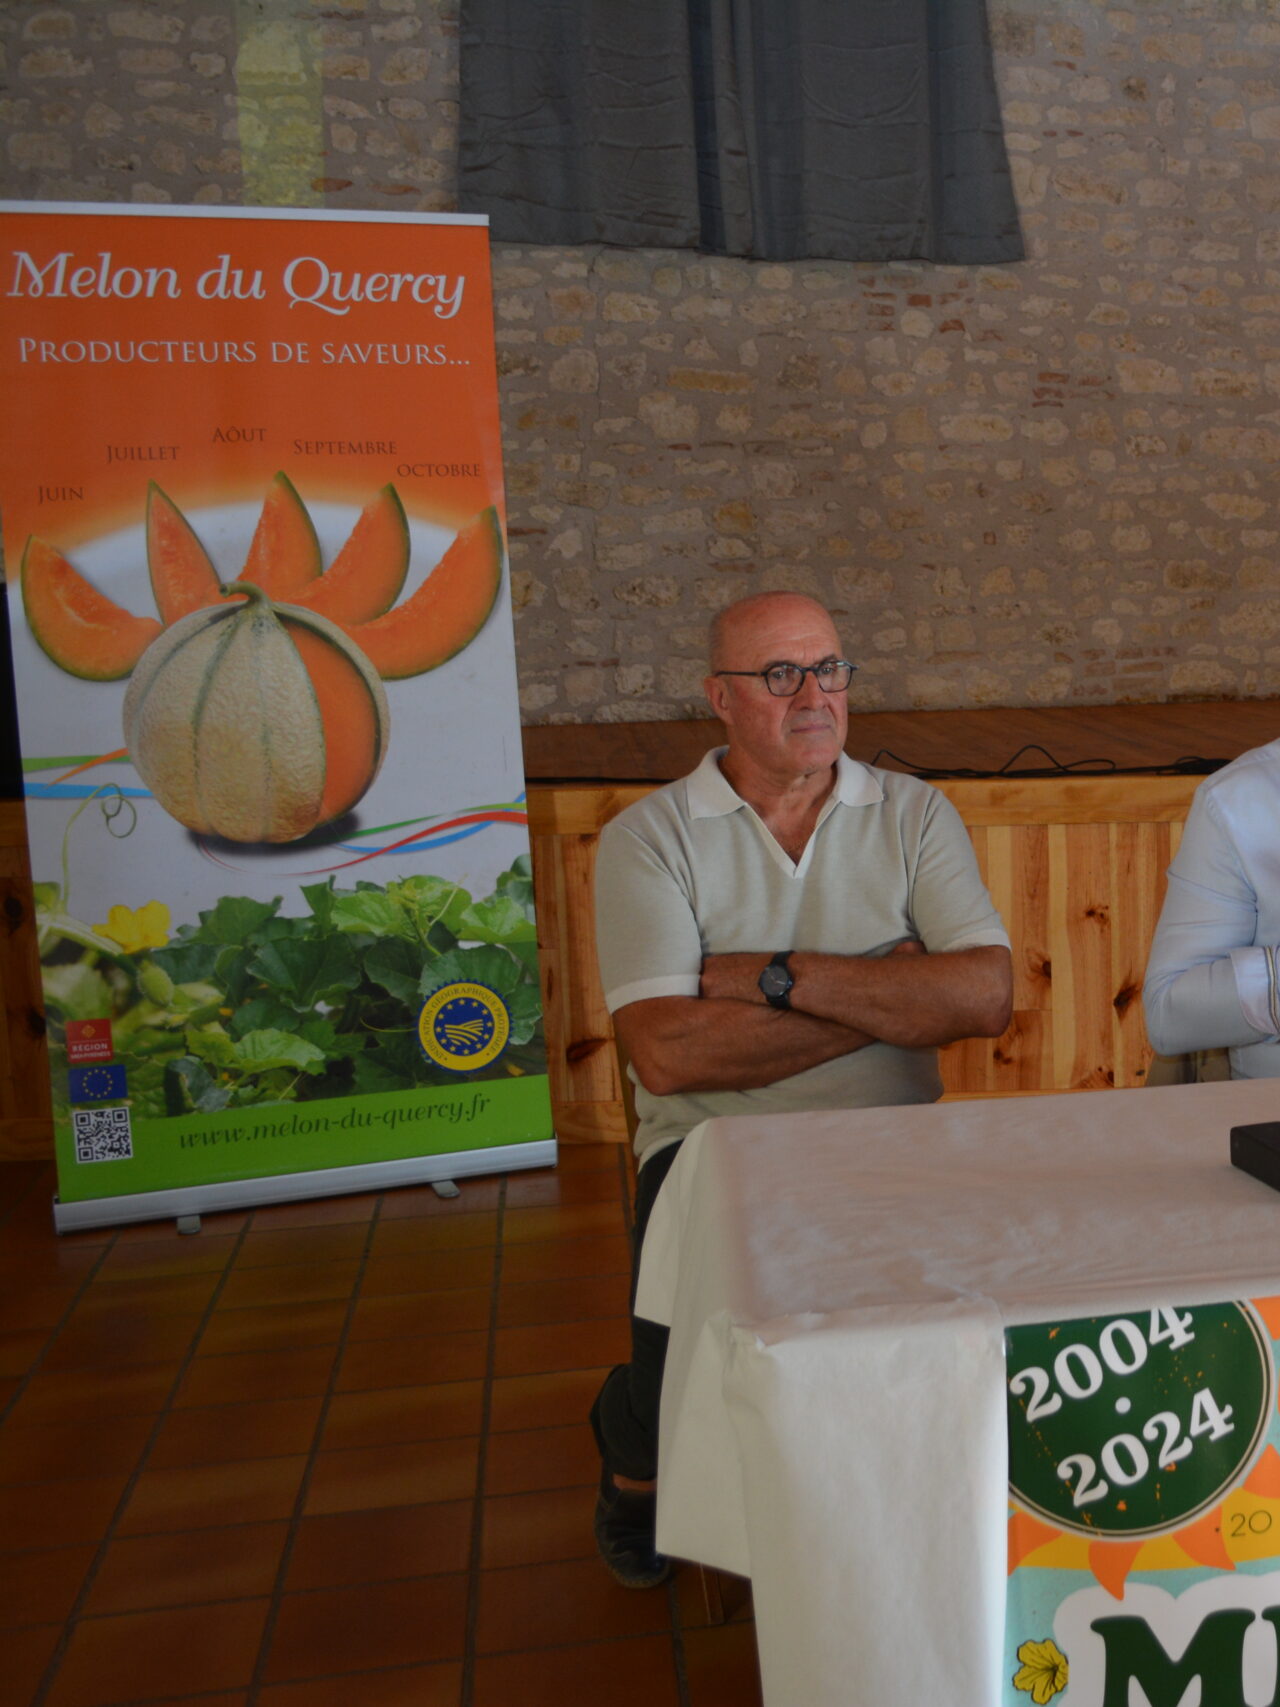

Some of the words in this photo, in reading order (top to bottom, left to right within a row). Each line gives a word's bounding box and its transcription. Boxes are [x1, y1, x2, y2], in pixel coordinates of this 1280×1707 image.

[6, 251, 181, 299] Melon
[196, 254, 266, 300] du
[282, 257, 466, 320] Quercy
[19, 337, 257, 364] PRODUCTEURS
[270, 341, 310, 363] DE
[321, 344, 471, 366] SAVEURS...
[106, 444, 180, 463] JUILLET
[293, 438, 397, 457] SEPTEMBRE
[397, 462, 482, 480] OCTOBRE
[37, 485, 84, 505] JUIN
[179, 1094, 492, 1150] www.melon-du-quercy.fr
[1012, 1306, 1198, 1422] 2004
[1056, 1387, 1235, 1508] 2024
[1228, 1508, 1274, 1540] 20
